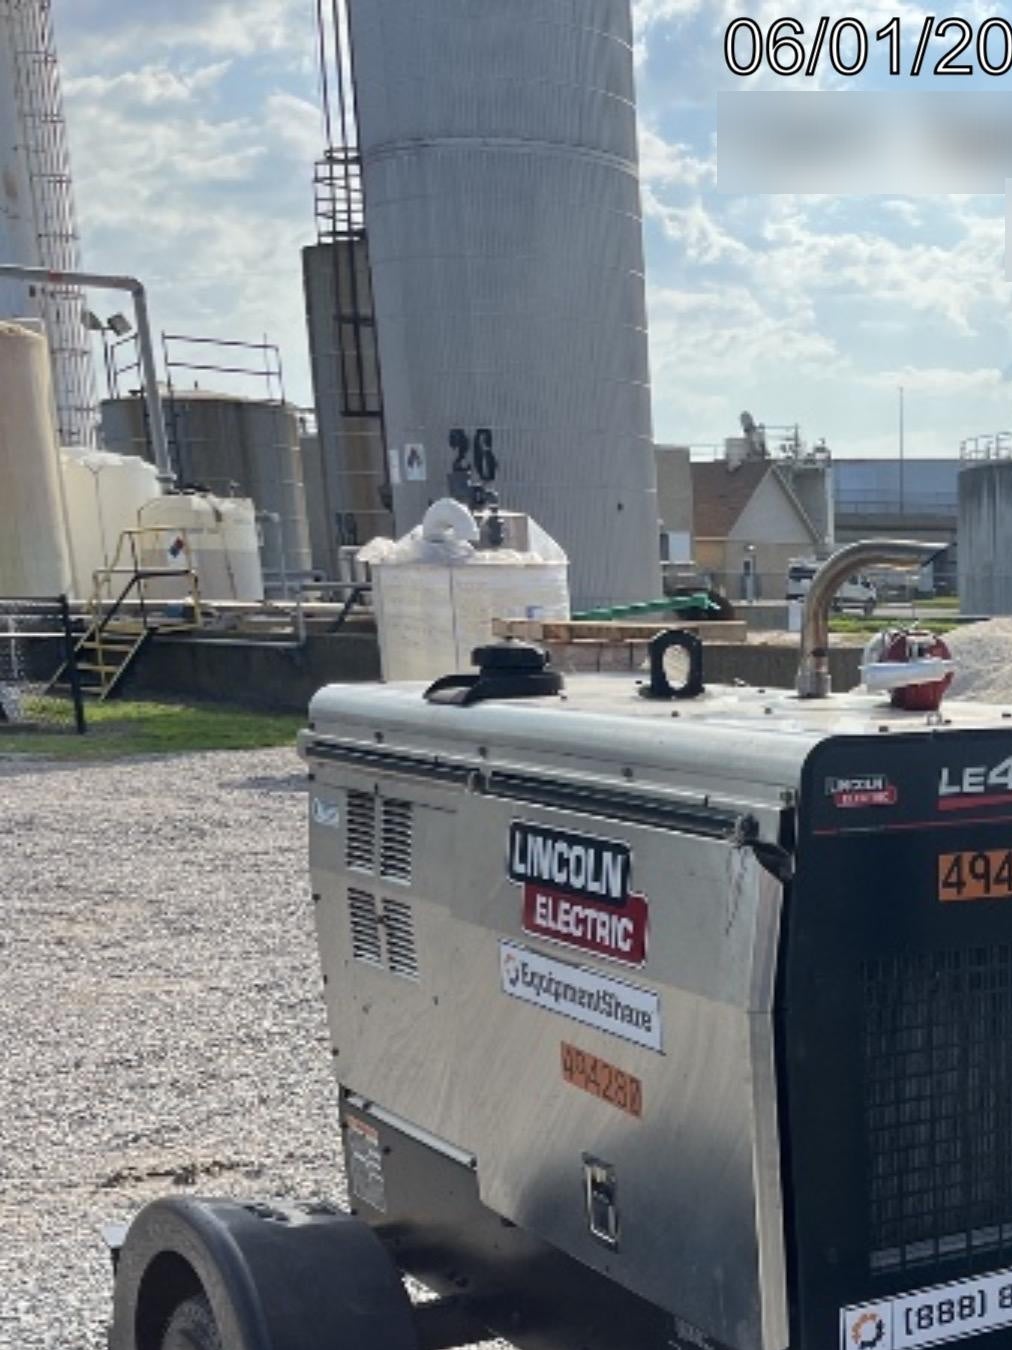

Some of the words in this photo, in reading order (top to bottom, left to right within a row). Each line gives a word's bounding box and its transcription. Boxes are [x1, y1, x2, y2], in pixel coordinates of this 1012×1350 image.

[449, 428, 498, 481] 26
[513, 828, 624, 899] LINCOLN
[535, 892, 634, 952] ELECTRIC
[520, 962, 653, 1033] EquipmentShare
